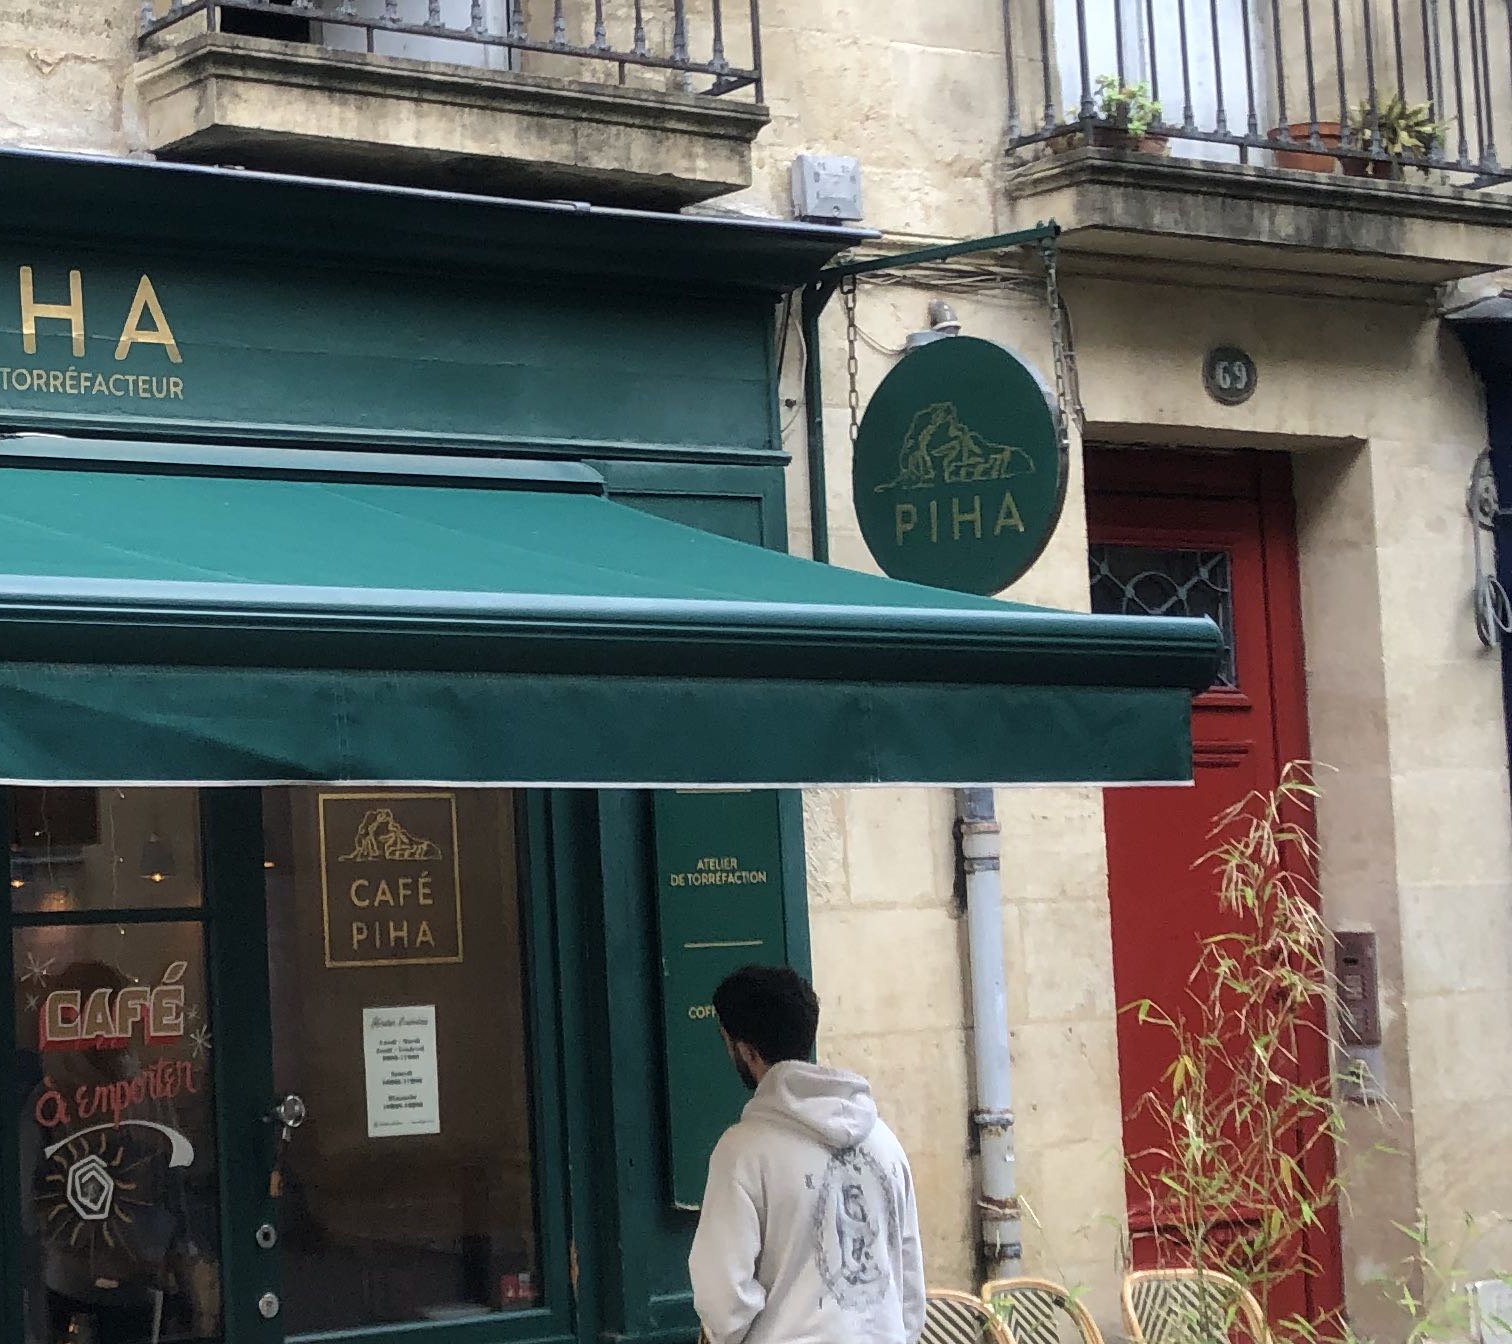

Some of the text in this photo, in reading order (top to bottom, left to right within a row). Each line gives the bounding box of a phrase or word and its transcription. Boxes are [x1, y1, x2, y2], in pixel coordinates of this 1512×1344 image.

[1215, 361, 1248, 389] 69
[894, 489, 1025, 546] PIHA
[670, 870, 767, 887] DE TORRÉFACTION
[696, 857, 738, 871] ATELIER
[350, 871, 434, 907] CAFÉ
[352, 920, 435, 951] PIHA
[40, 961, 187, 1050] CAFÉ
